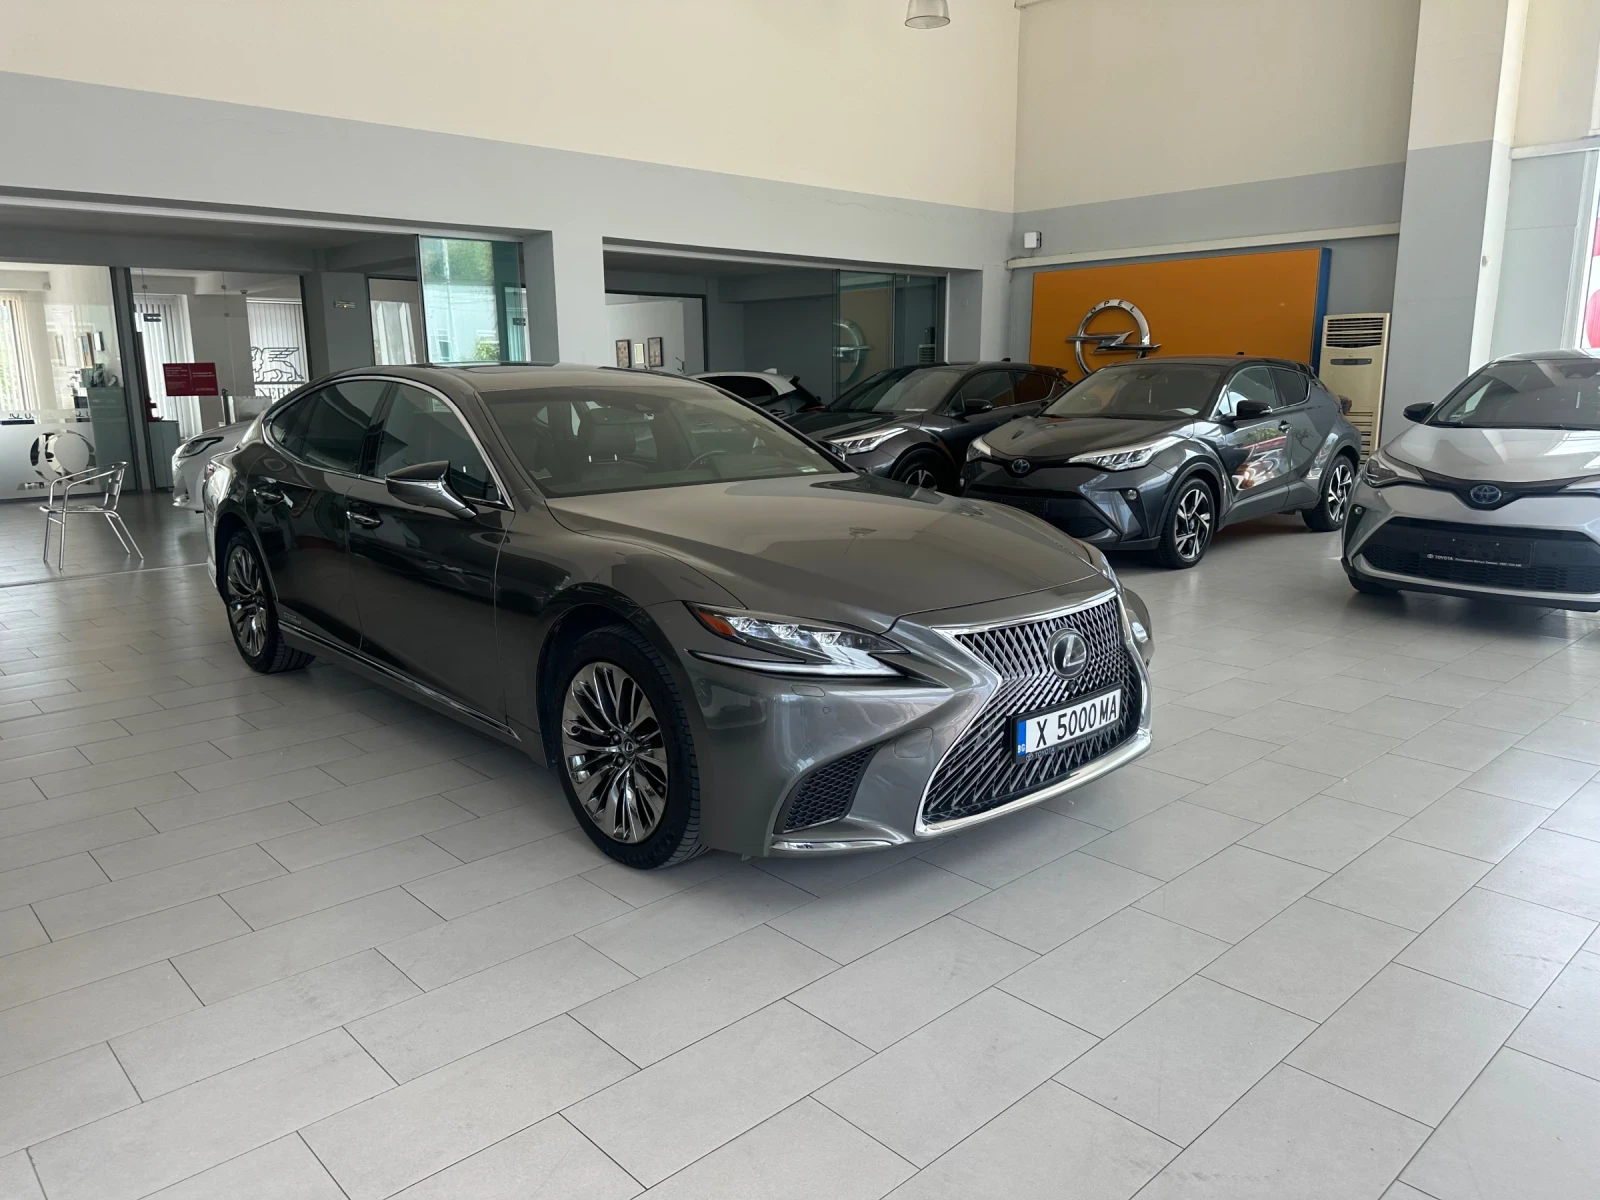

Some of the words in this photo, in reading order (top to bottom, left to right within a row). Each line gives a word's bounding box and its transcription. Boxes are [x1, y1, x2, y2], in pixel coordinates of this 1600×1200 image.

[1090, 300, 1135, 314] OPEL
[1036, 718, 1048, 748] X
[1034, 747, 1055, 758] TOYOTA
